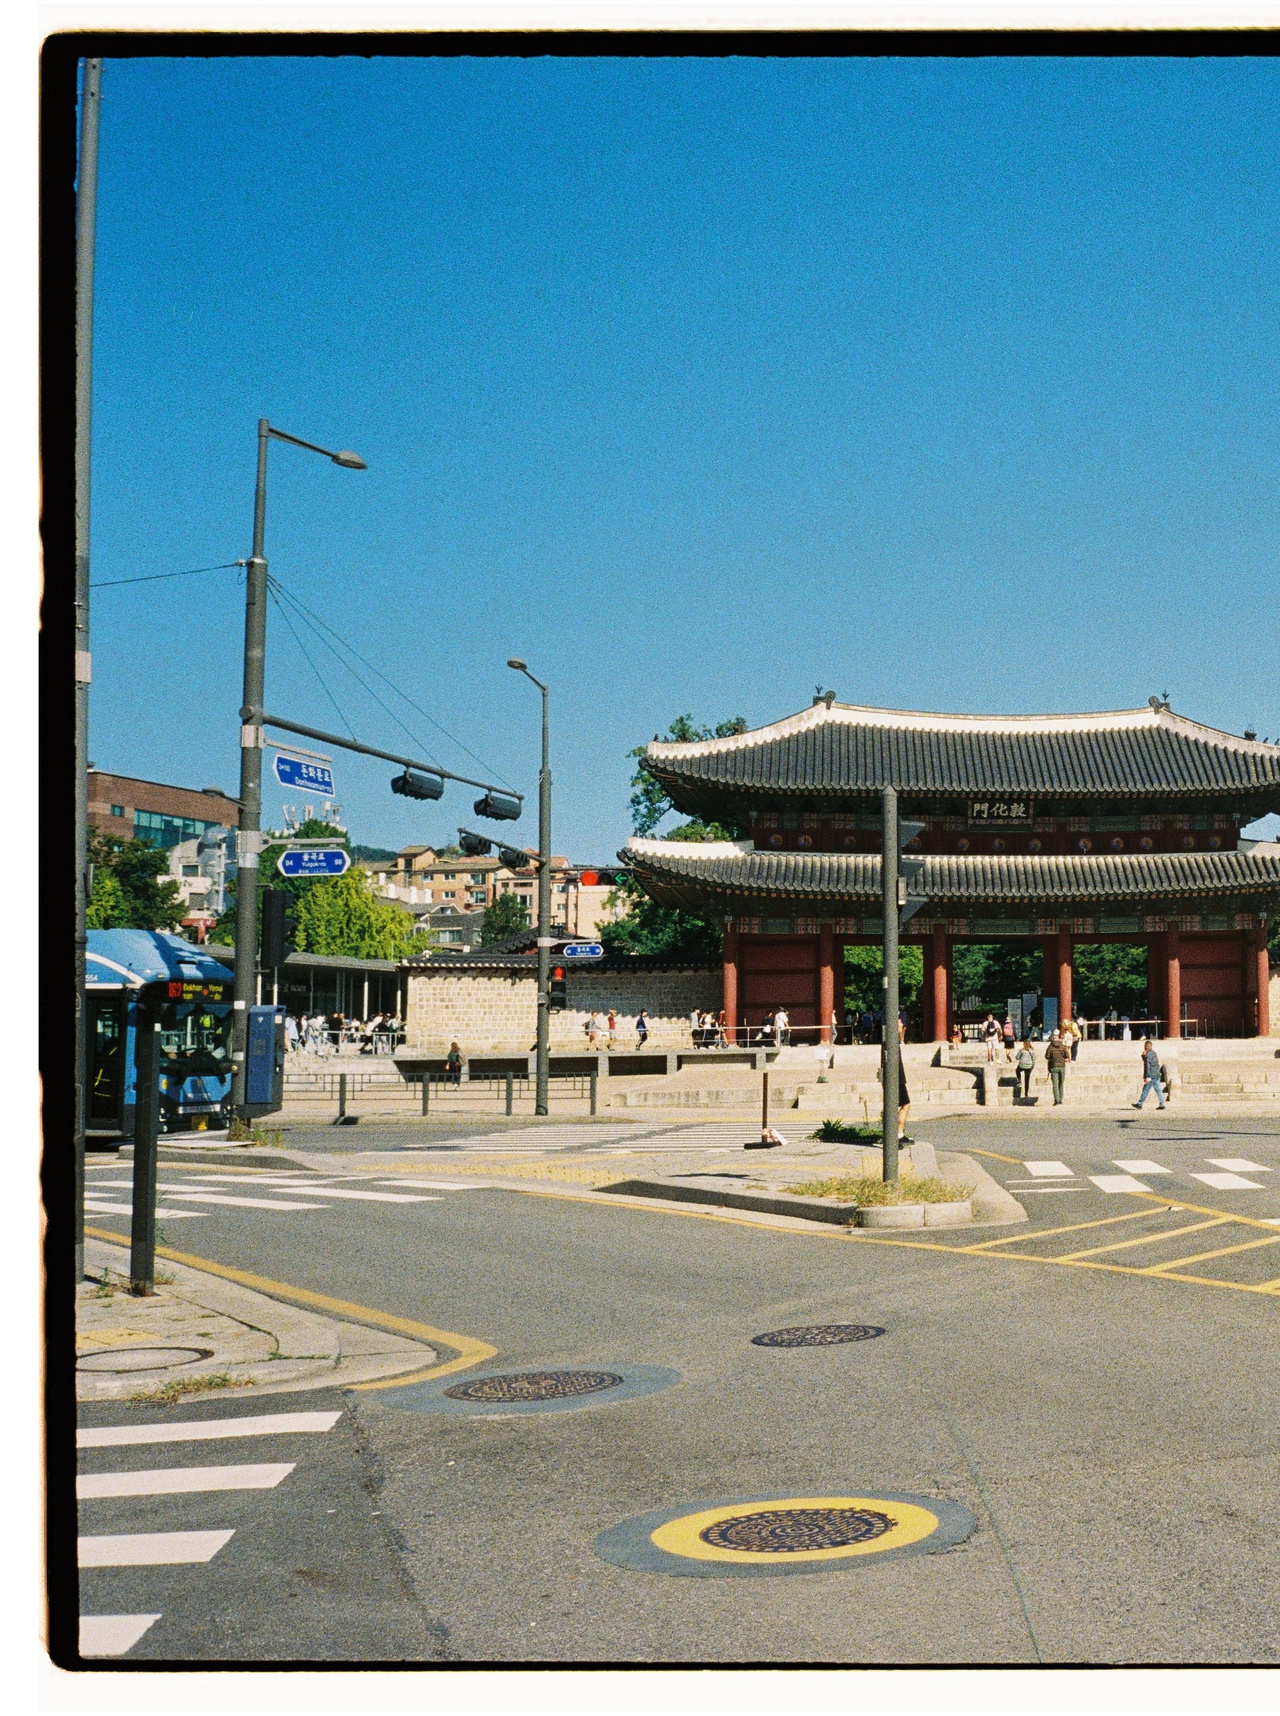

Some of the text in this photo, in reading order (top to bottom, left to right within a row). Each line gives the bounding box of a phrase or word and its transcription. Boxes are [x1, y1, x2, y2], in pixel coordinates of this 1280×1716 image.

[301, 764, 331, 782] 돈화문로
[294, 776, 332, 793] Donhwamun-ro
[285, 859, 294, 867] 94
[302, 852, 326, 862] 율곡로
